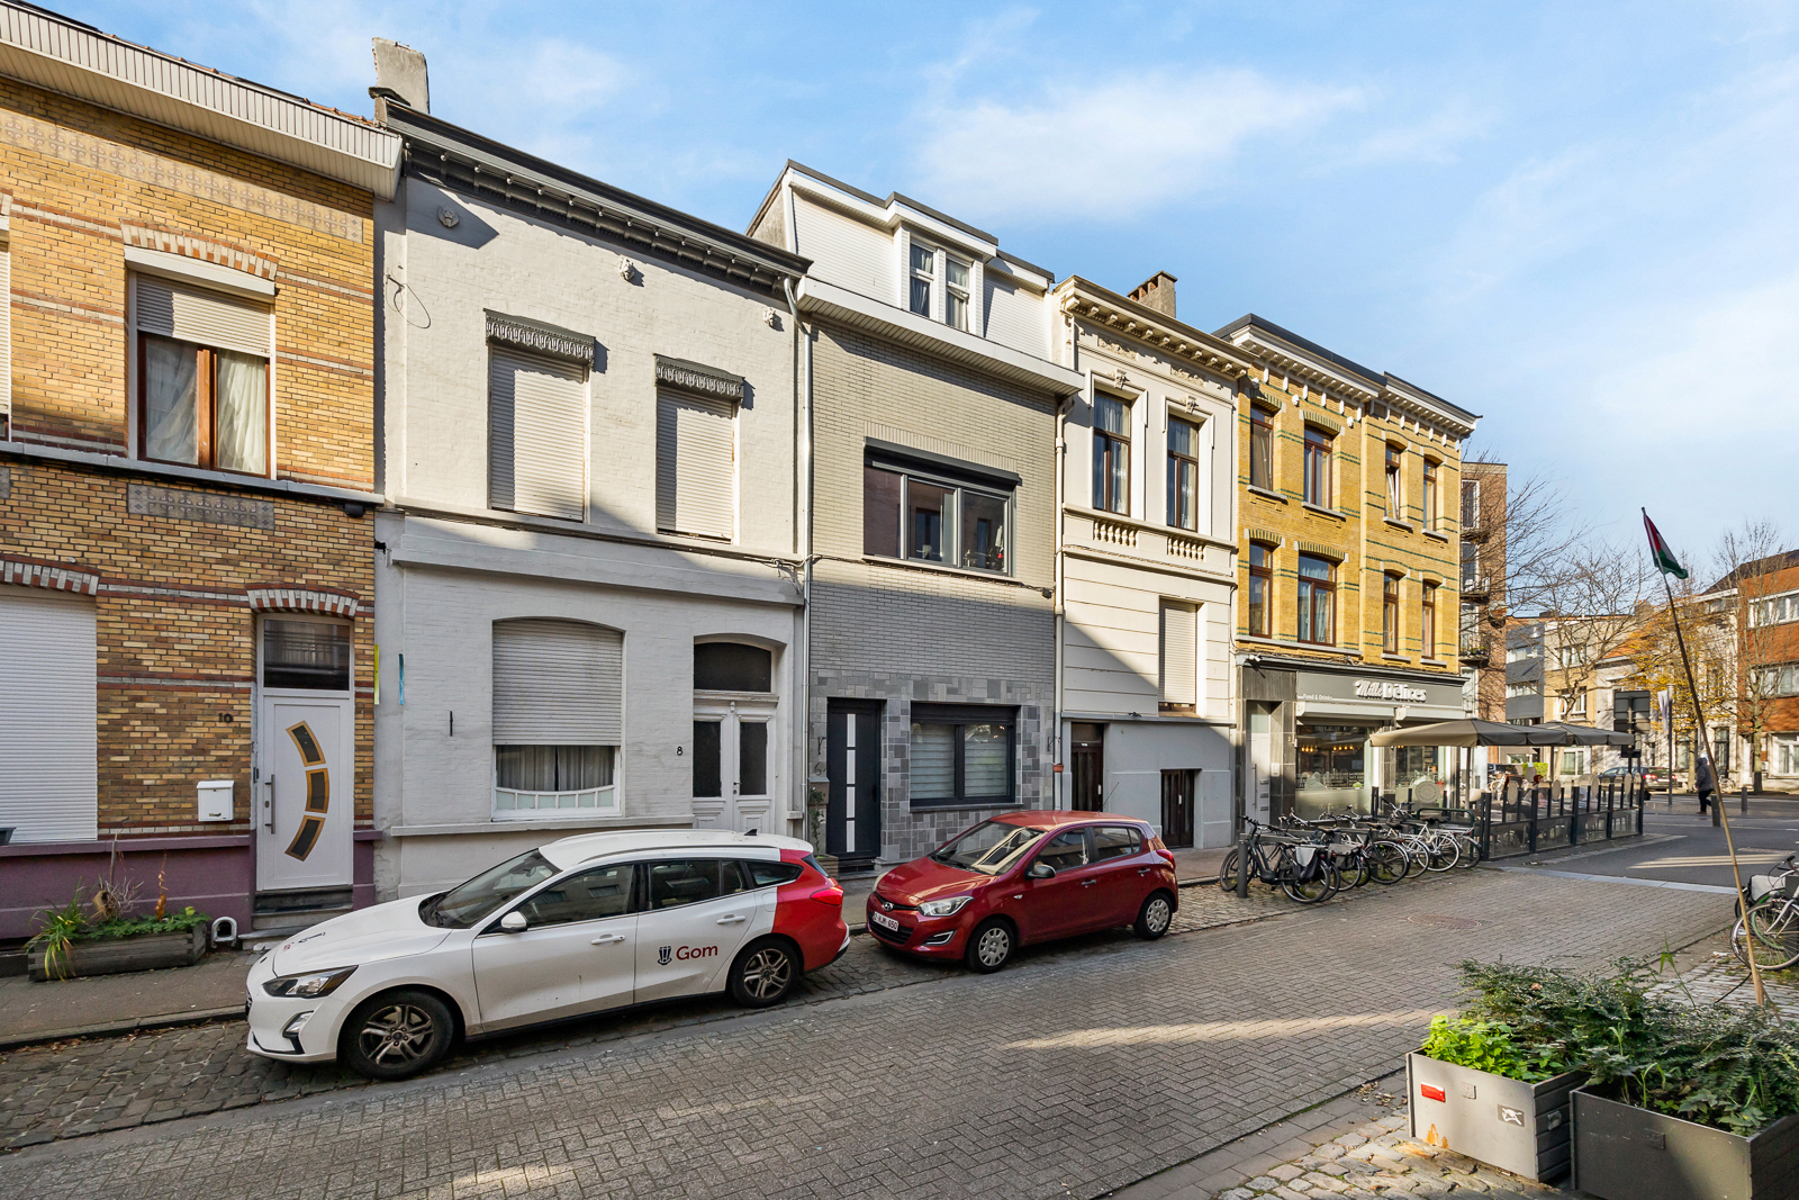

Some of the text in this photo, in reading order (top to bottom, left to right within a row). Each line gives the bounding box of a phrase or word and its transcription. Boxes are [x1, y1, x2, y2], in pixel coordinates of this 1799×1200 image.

[218, 712, 234, 723] 10
[677, 746, 683, 756] 8
[676, 945, 718, 961] Gom
